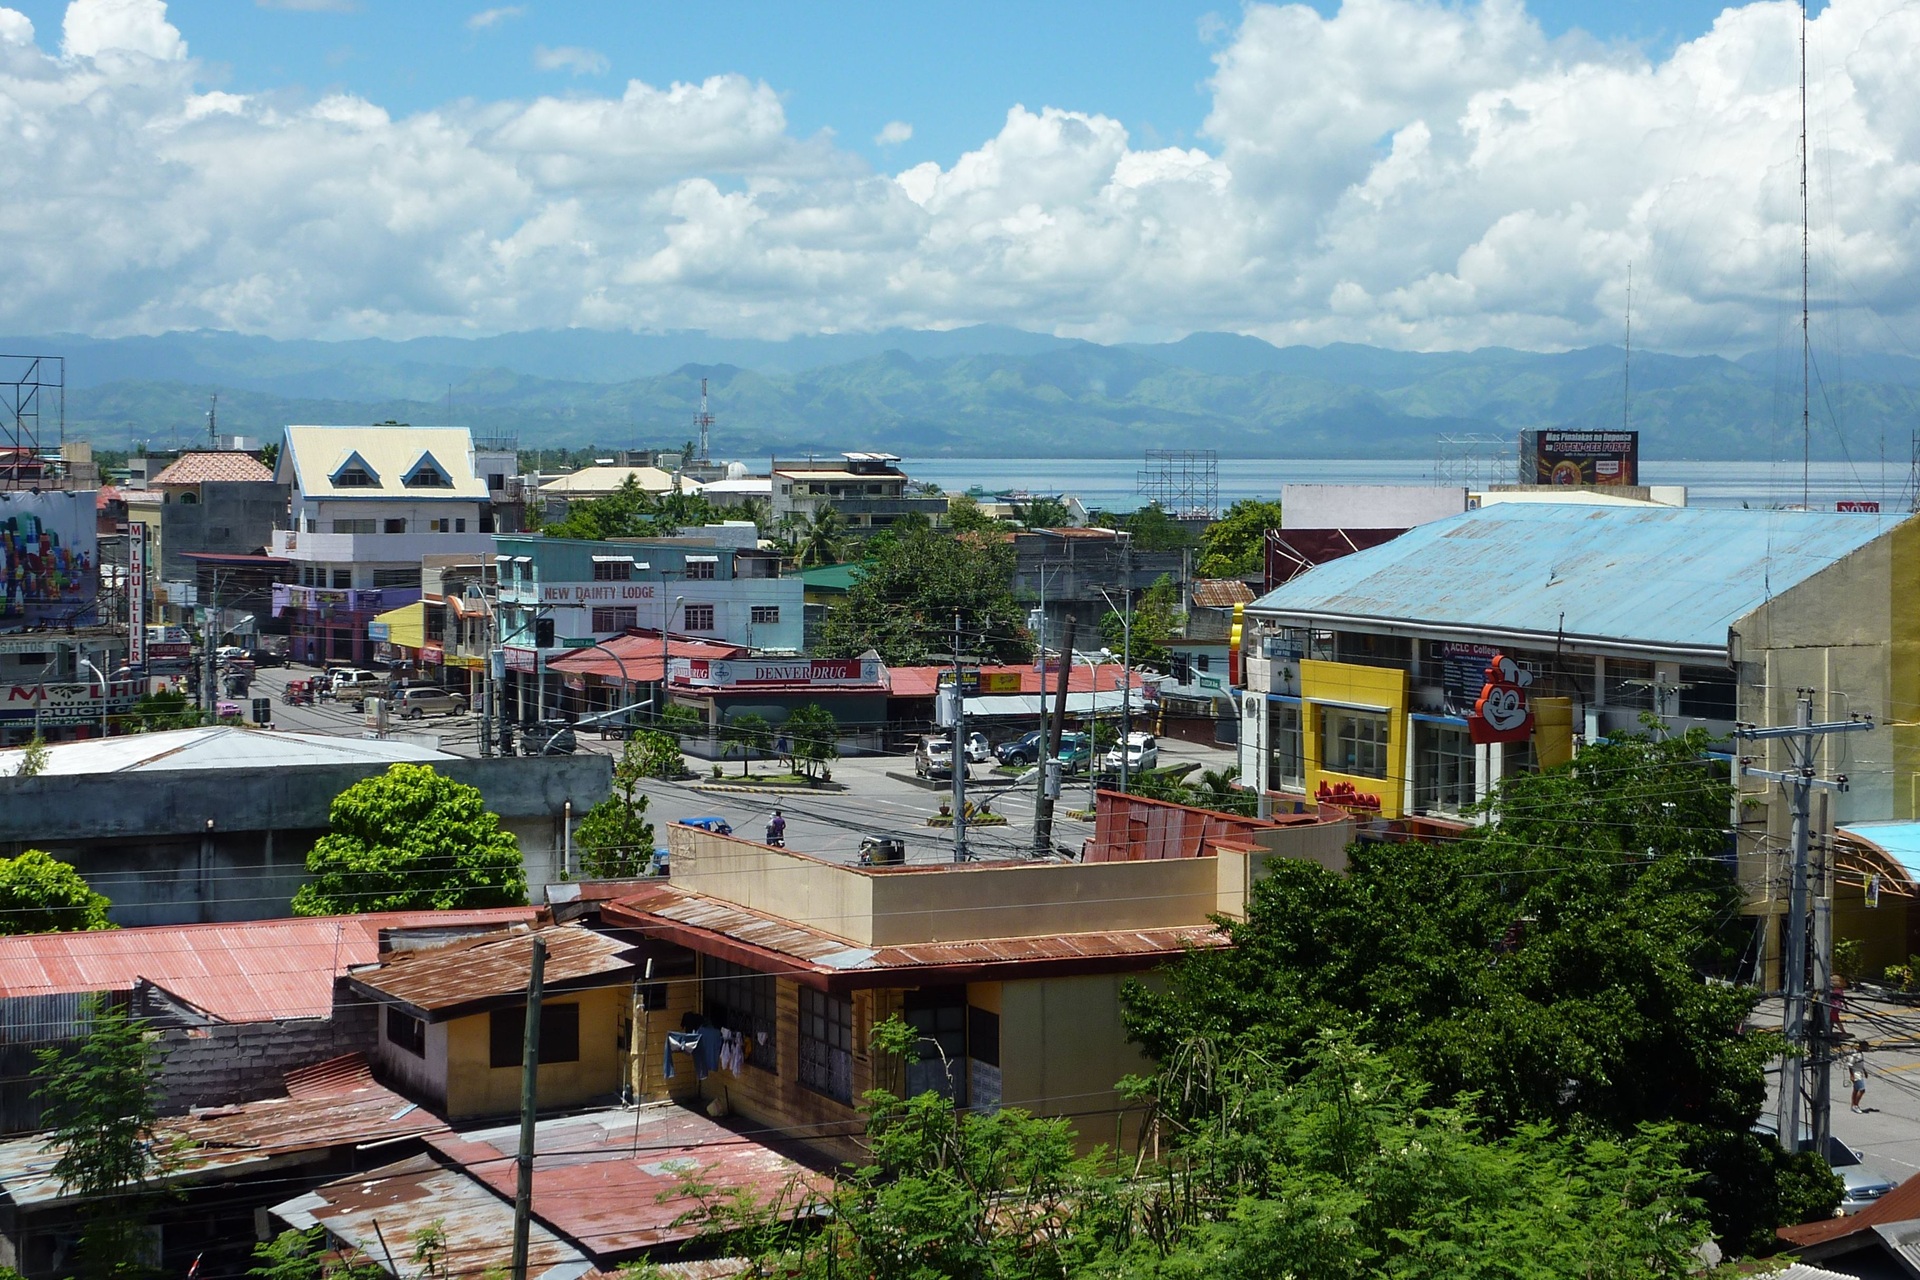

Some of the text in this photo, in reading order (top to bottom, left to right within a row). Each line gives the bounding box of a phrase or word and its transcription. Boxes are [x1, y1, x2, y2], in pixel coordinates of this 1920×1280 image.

[1553, 442, 1601, 452] POTEN-CEE
[1602, 442, 1631, 452] FORTE
[131, 525, 140, 661] M LHUILLIER
[544, 586, 569, 600] NEW
[575, 586, 616, 599] DAINTY
[622, 586, 655, 599] LODGE
[0, 641, 44, 652] SANTOS
[1450, 643, 1500, 657] ACLC College
[8, 684, 48, 701] M
[50, 699, 121, 707] NUMERO
[40, 706, 108, 717] QUICK
